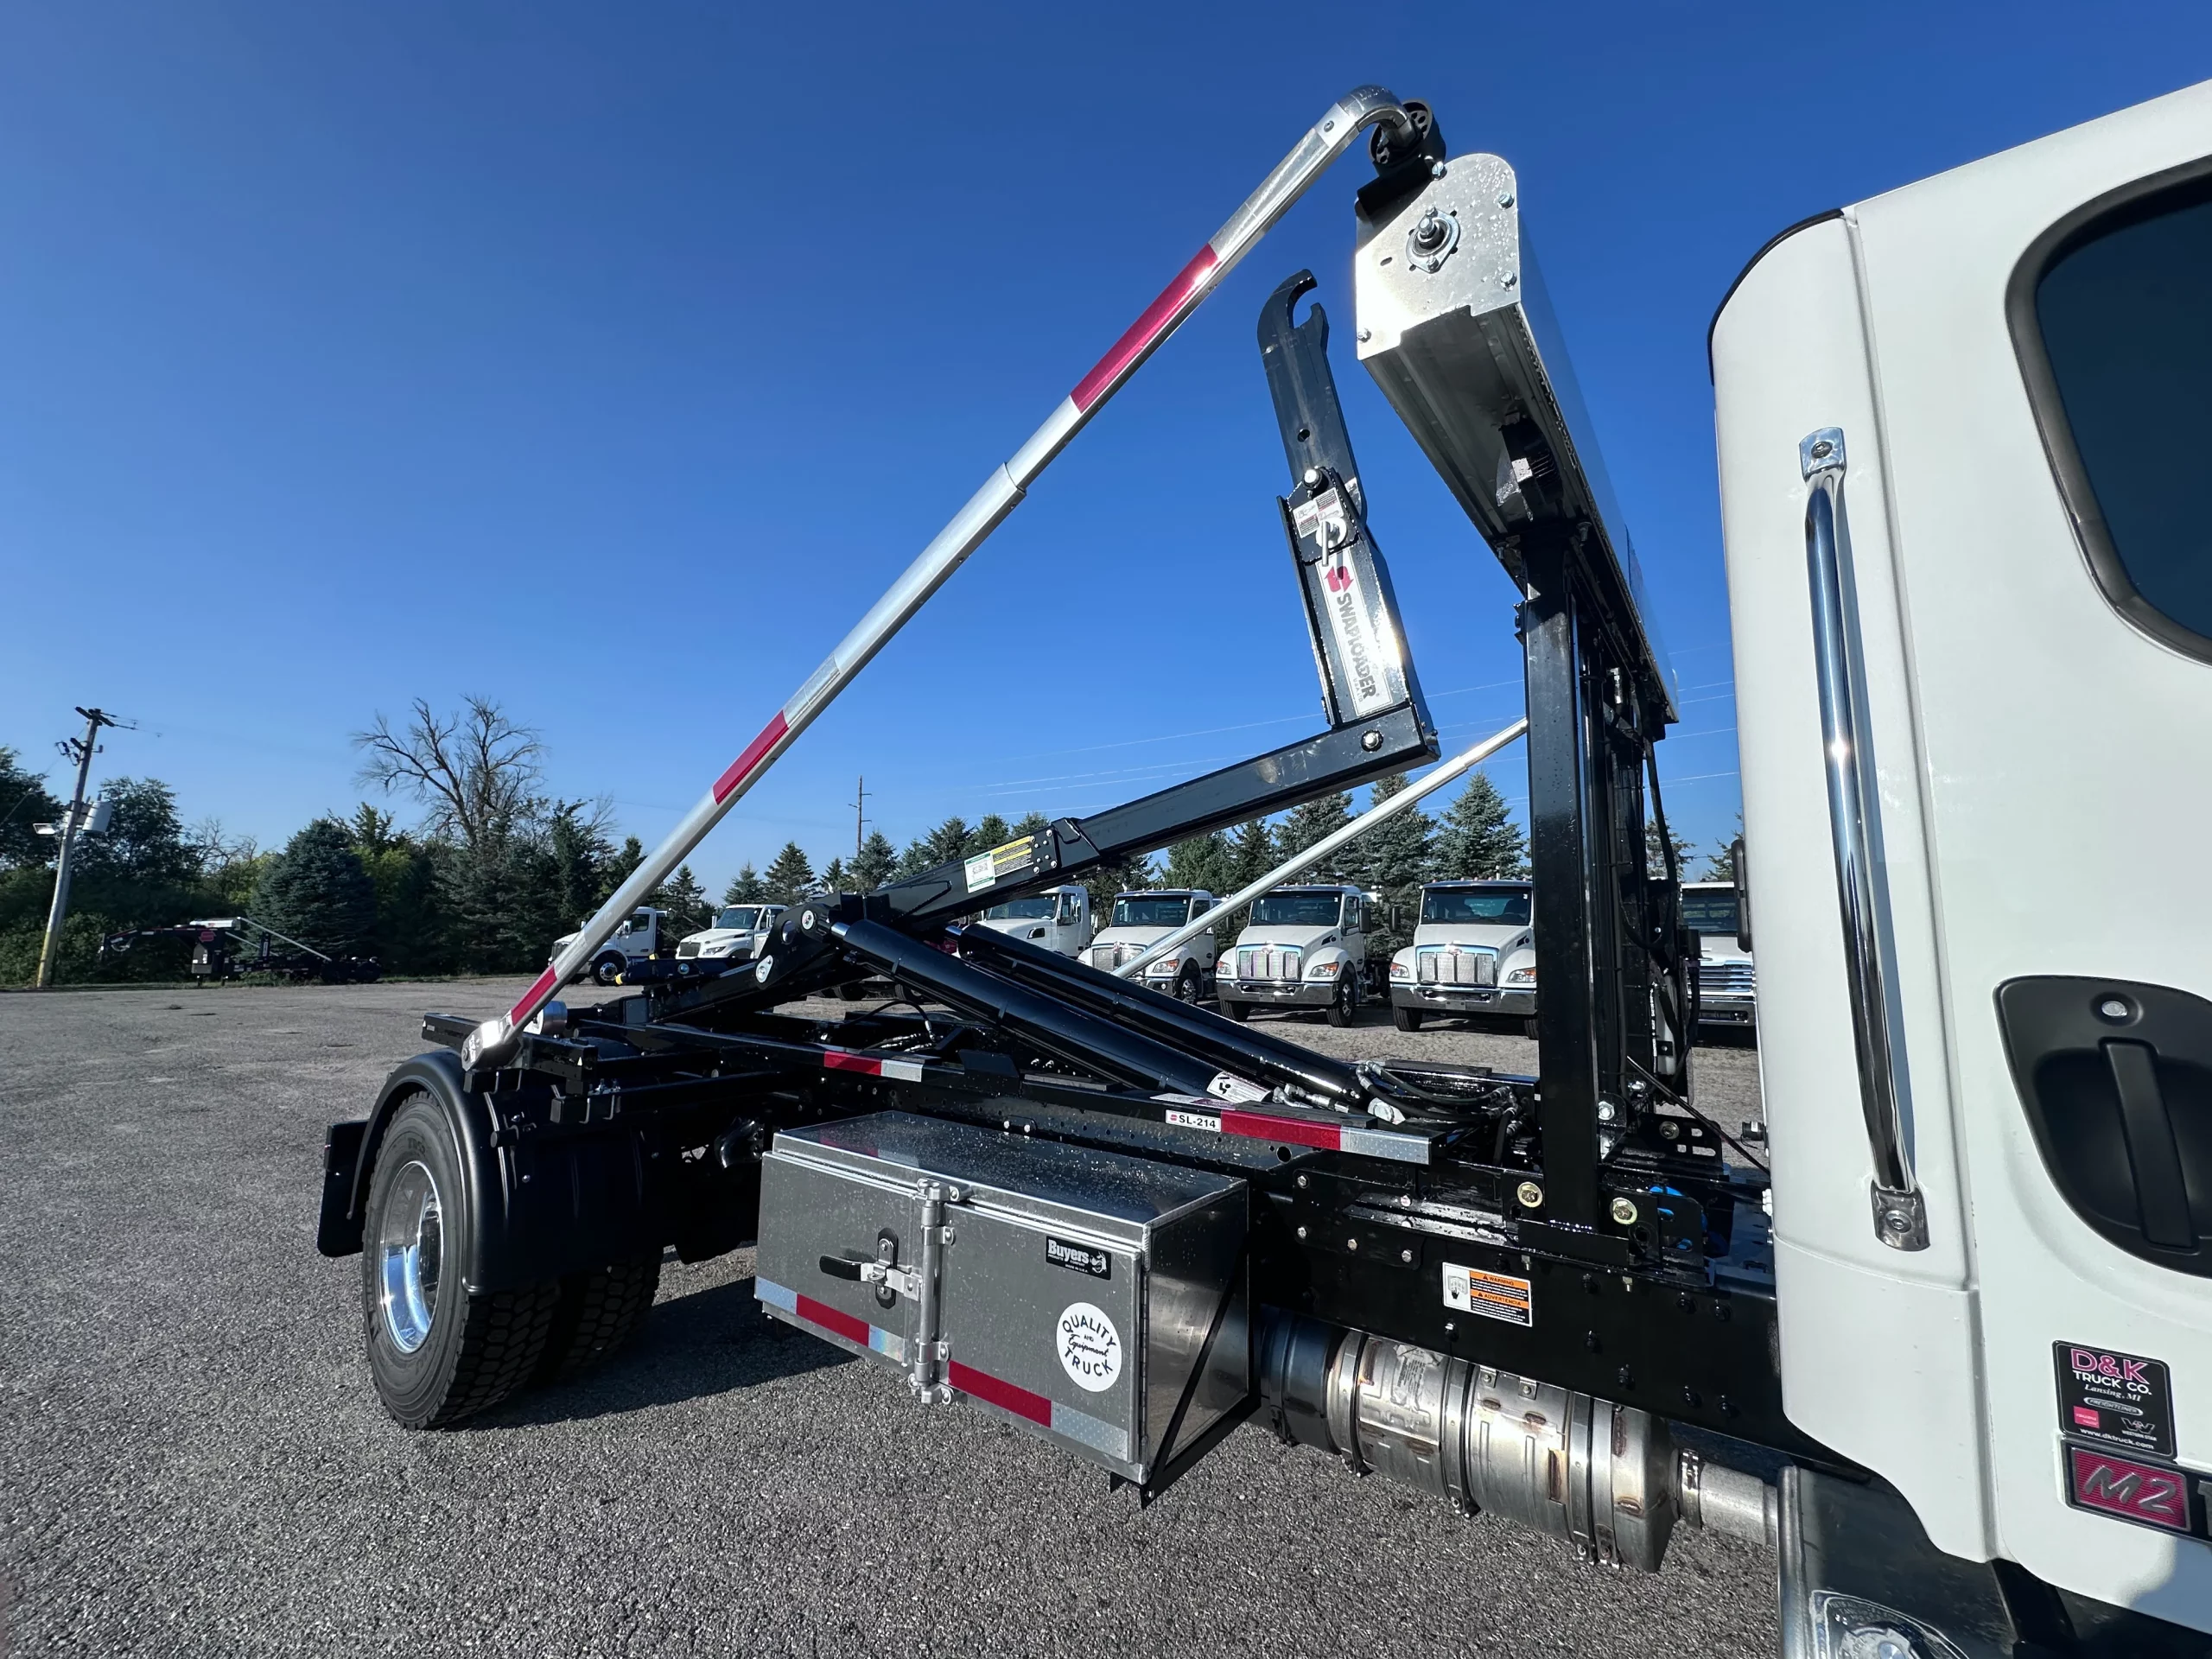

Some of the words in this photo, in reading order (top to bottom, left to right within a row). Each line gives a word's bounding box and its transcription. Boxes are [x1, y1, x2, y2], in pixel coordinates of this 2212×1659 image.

[1337, 593, 1376, 699] SWAPLOADER
[1179, 1115, 1216, 1128] SL-214
[1048, 1239, 1089, 1264] Buyers
[1489, 1276, 1514, 1286] WARNING
[1484, 1294, 1522, 1306] ADVERTENCIA
[1063, 1314, 1116, 1347] QUALITY
[1069, 1333, 1109, 1357] Equipment
[1065, 1346, 1113, 1377] TRUCK
[2070, 1348, 2150, 1384] D&K
[2073, 1370, 2121, 1389] TRUCK
[2126, 1382, 2152, 1395] CO.
[2089, 1399, 2138, 1414] FREIGHTLINER
[2126, 1393, 2141, 1402] MI
[2079, 1428, 2154, 1450] www.dktruck.com
[2083, 1465, 2176, 1514] M2
